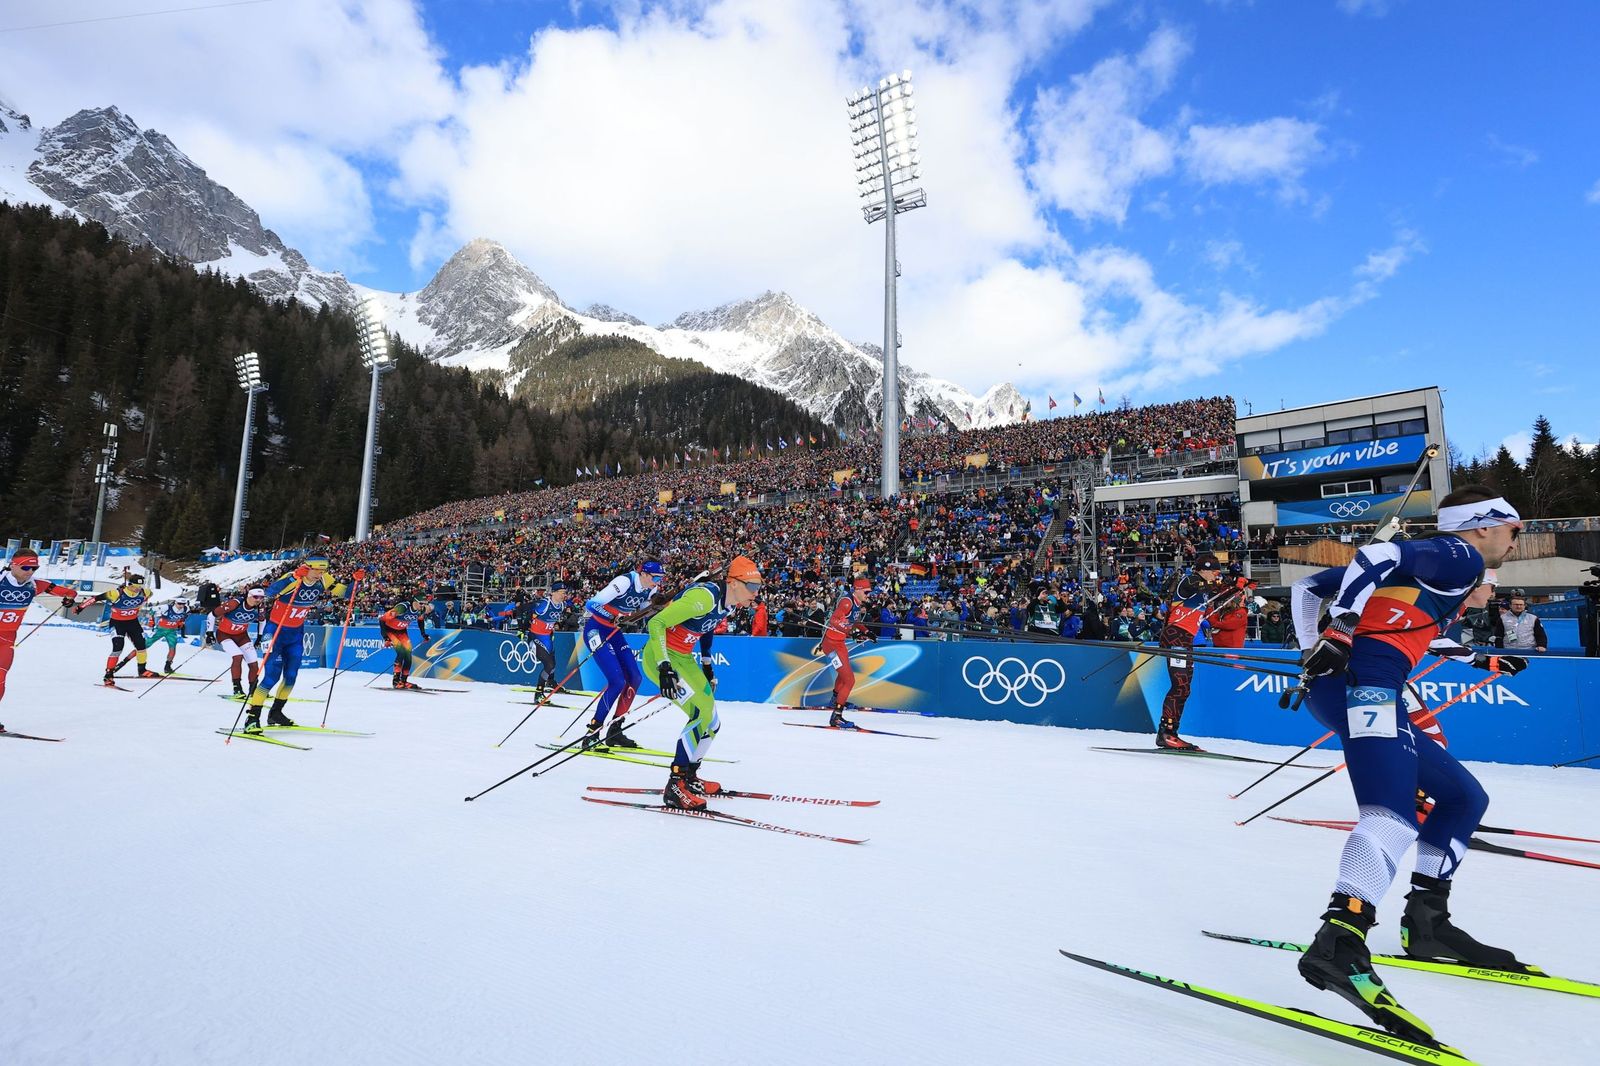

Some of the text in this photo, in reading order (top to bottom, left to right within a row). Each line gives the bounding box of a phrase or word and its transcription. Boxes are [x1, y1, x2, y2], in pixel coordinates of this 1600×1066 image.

[1261, 439, 1399, 479] IT's your vibe
[362, 639, 388, 649] CORTIN
[1362, 710, 1378, 728] 7
[1467, 968, 1531, 982] FISCHER
[1357, 1029, 1441, 1060] FISCHER
